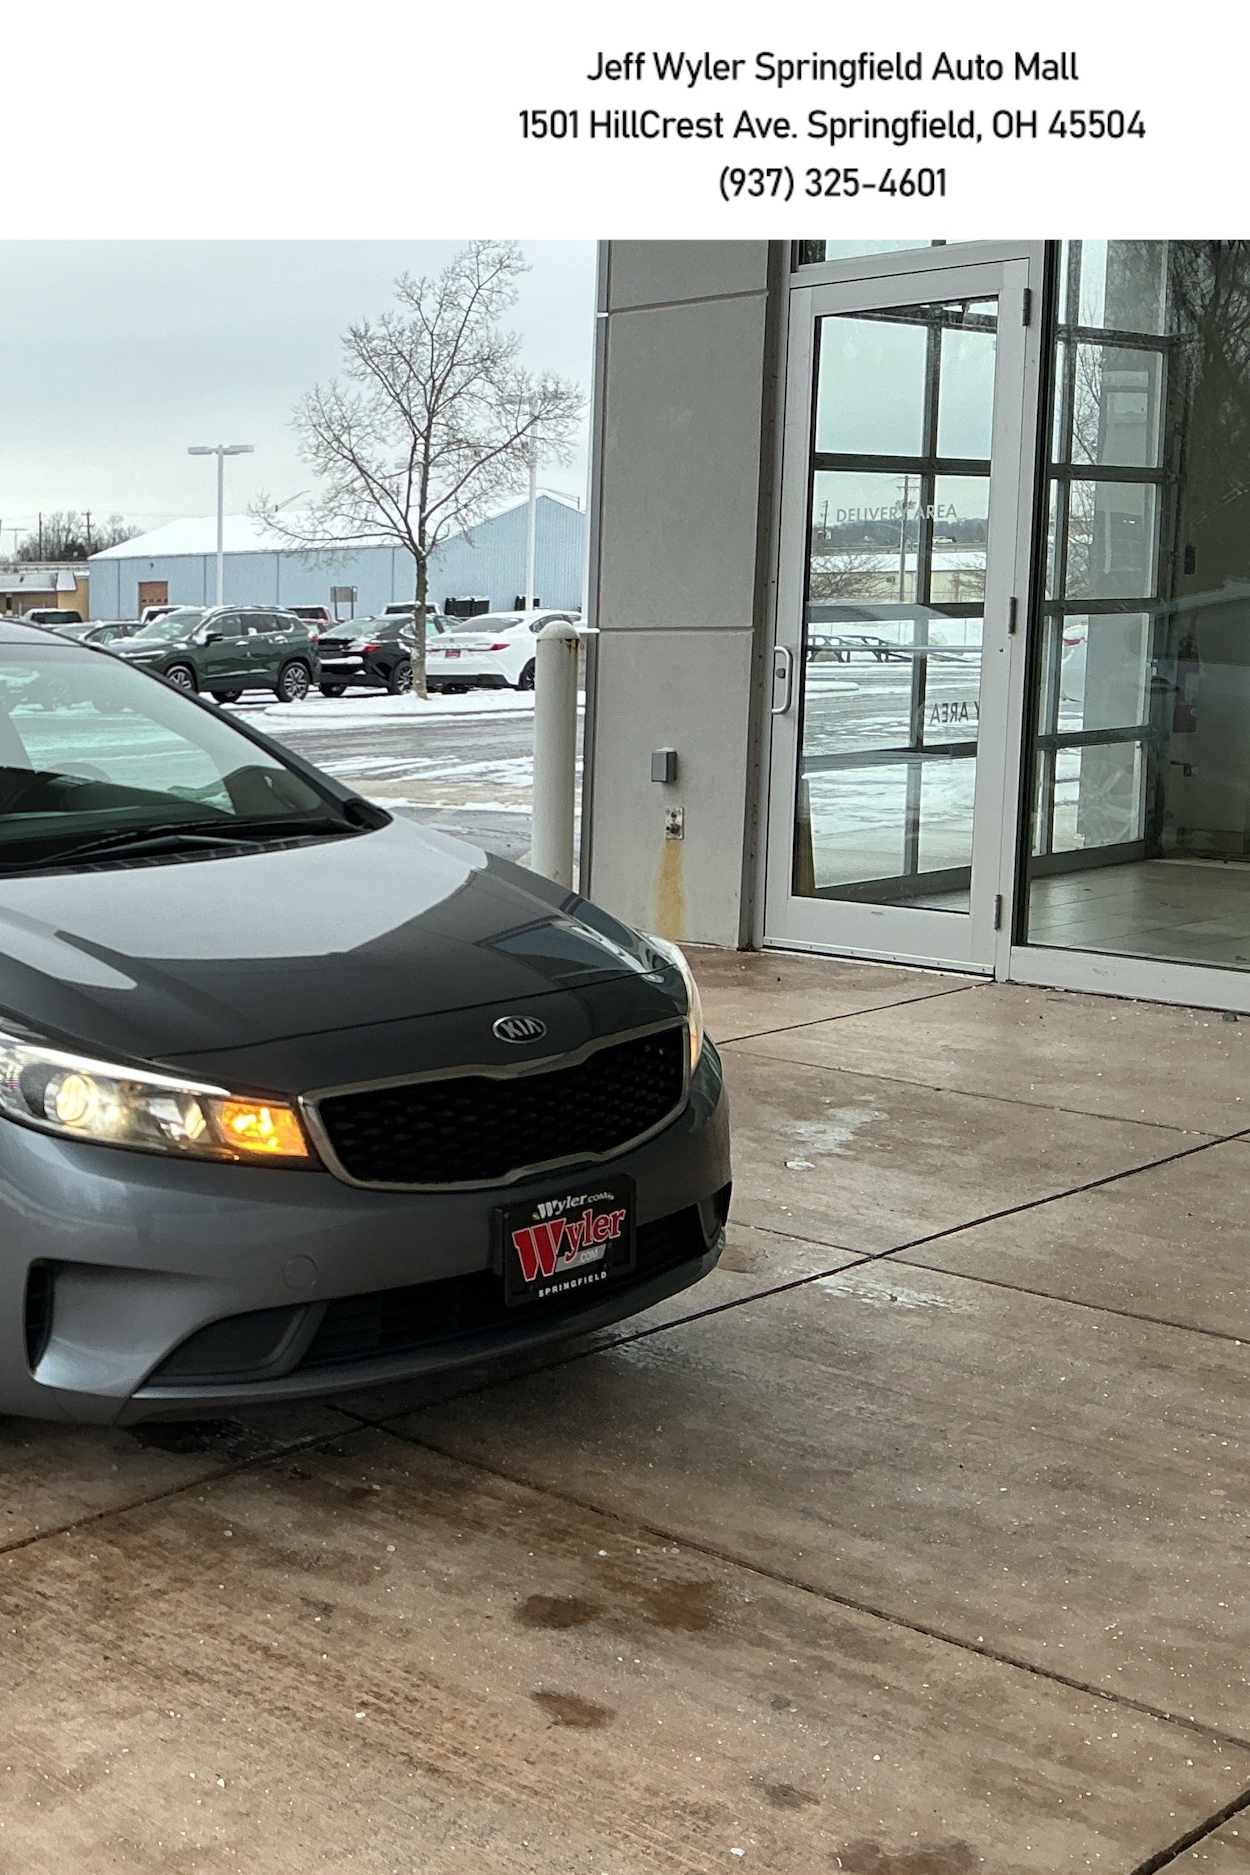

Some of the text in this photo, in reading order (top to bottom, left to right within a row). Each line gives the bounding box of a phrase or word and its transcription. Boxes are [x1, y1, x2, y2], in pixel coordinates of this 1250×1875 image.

[836, 503, 957, 522] DELIVERY AREA
[499, 1017, 544, 1039] KIA
[511, 1208, 627, 1282] Wyler
[538, 1271, 608, 1298] SPRINGFIELD
